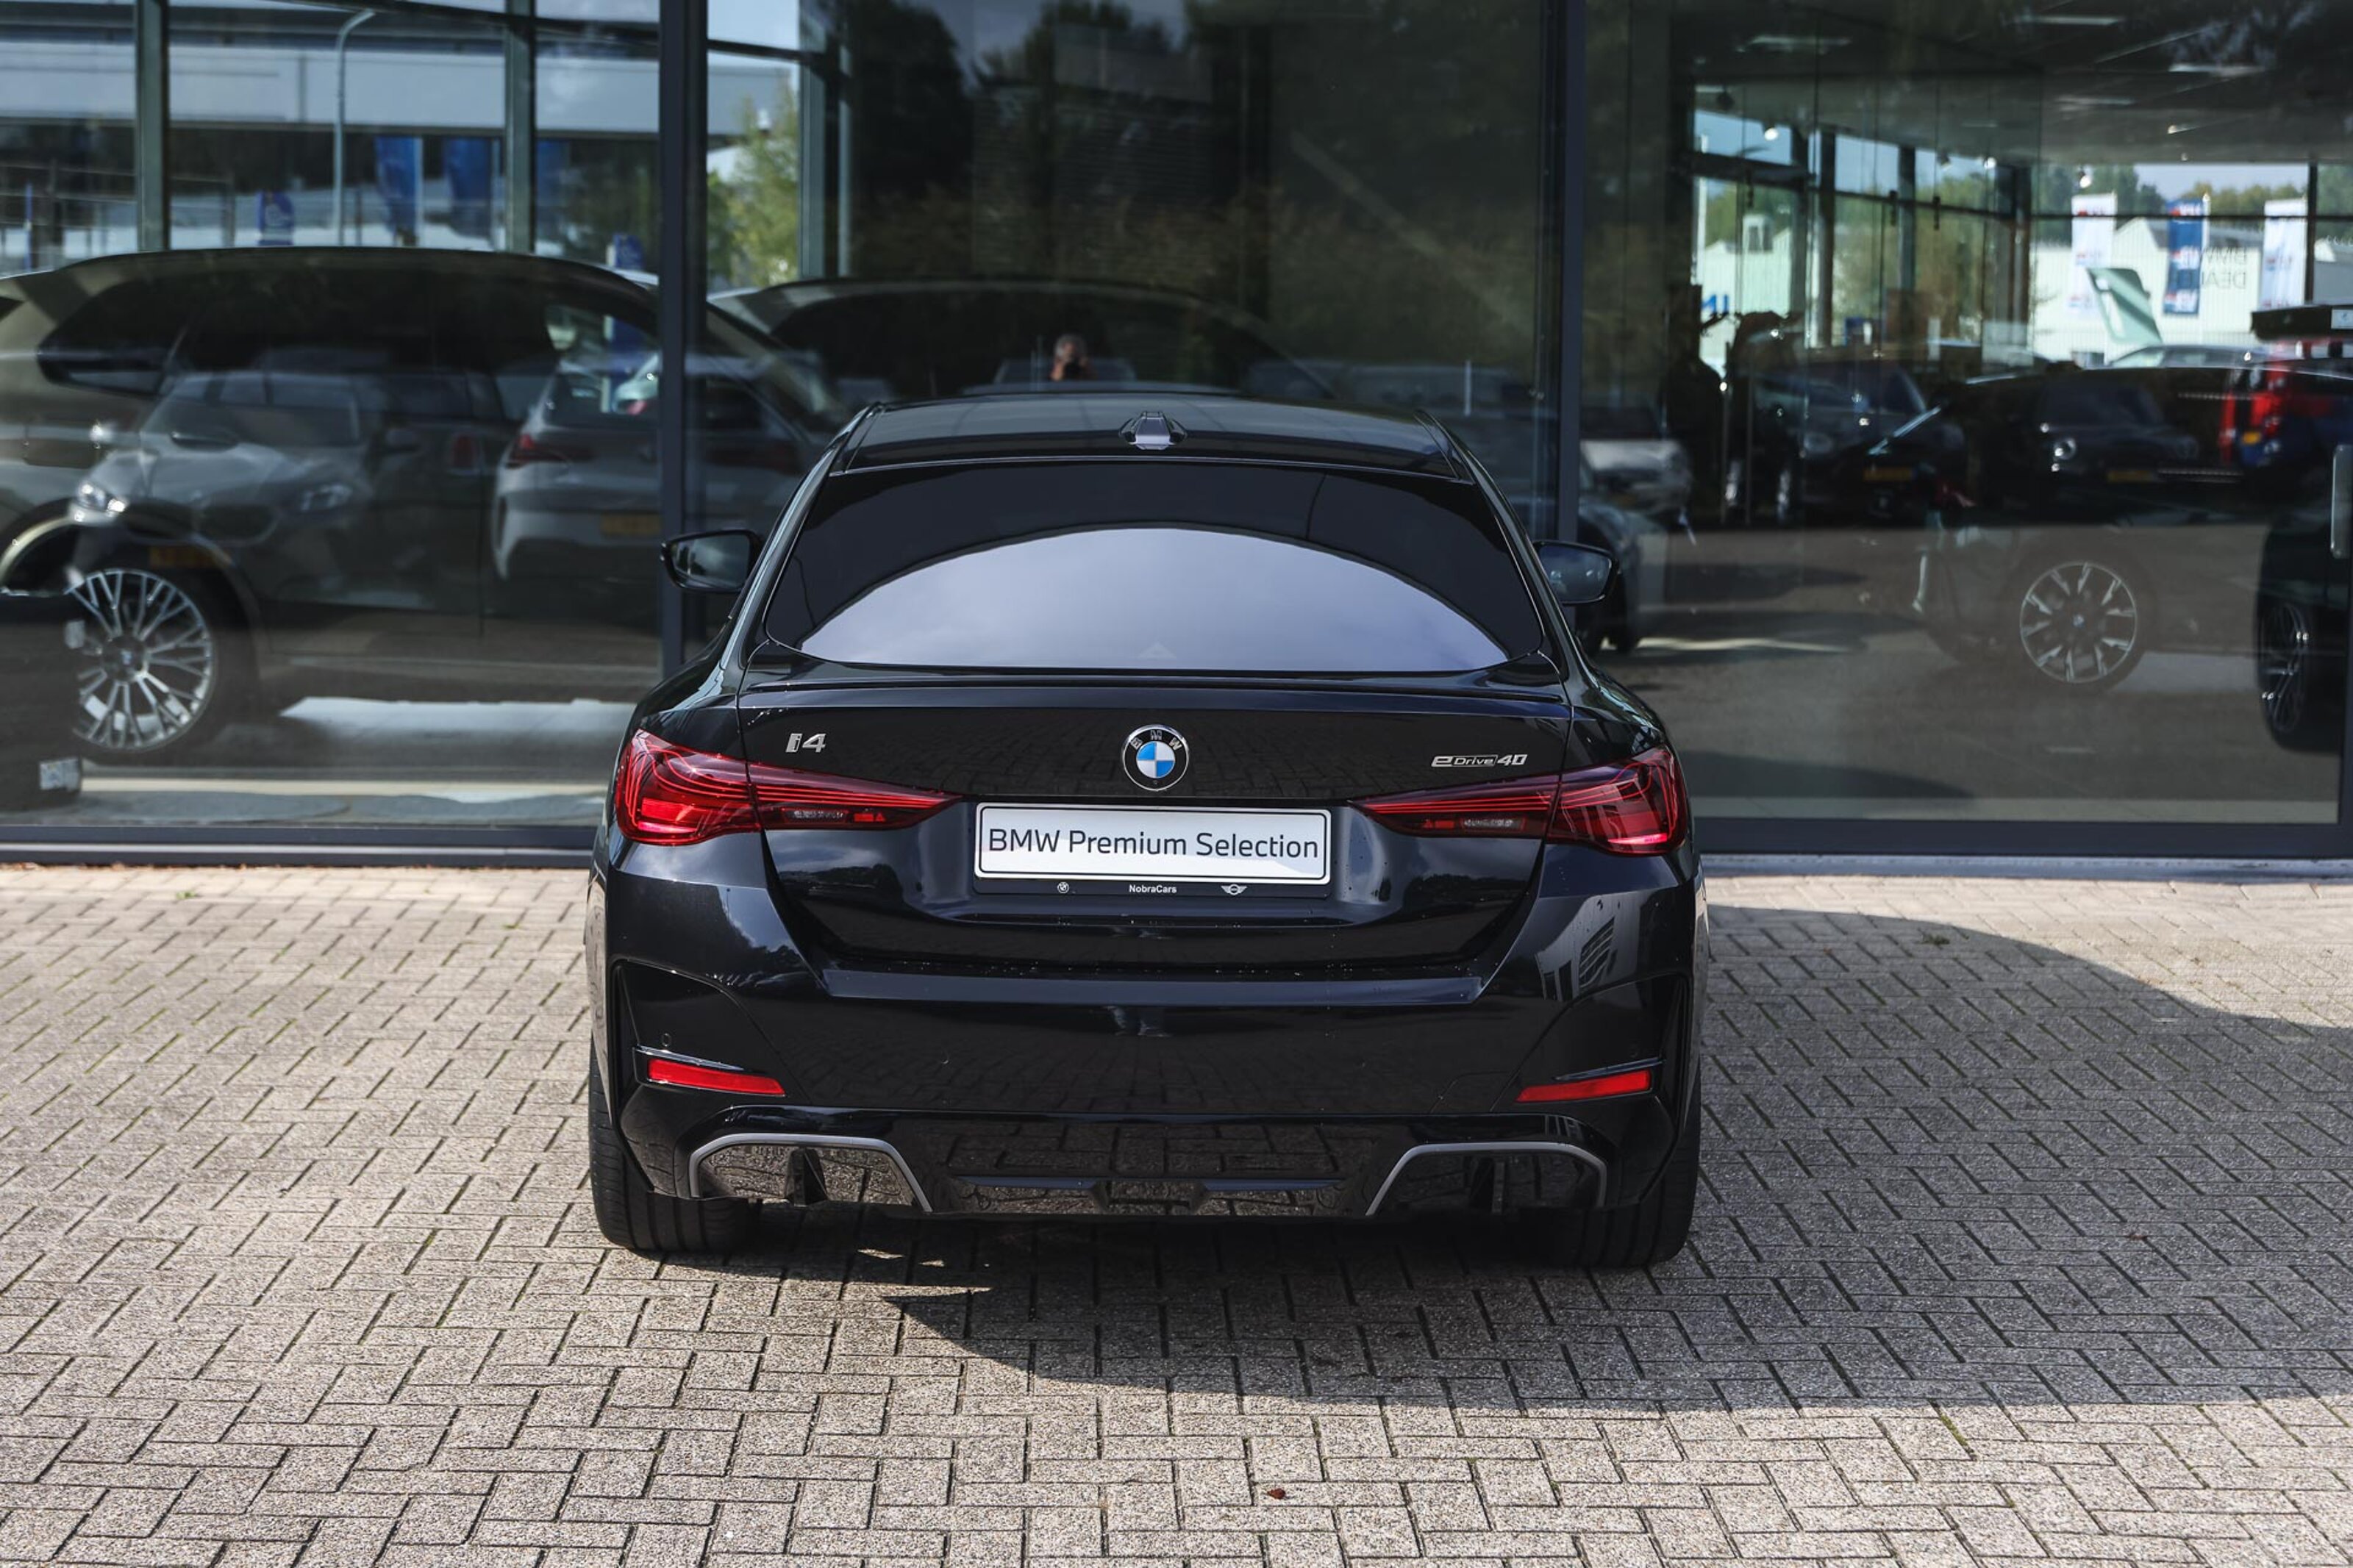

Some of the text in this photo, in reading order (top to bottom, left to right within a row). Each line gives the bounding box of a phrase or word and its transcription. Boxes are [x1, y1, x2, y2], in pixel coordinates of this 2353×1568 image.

[785, 734, 826, 752] i4
[1130, 730, 1182, 750] BMW
[989, 828, 1318, 859] BMW Premium Selection
[1129, 884, 1177, 894] NobraCars
